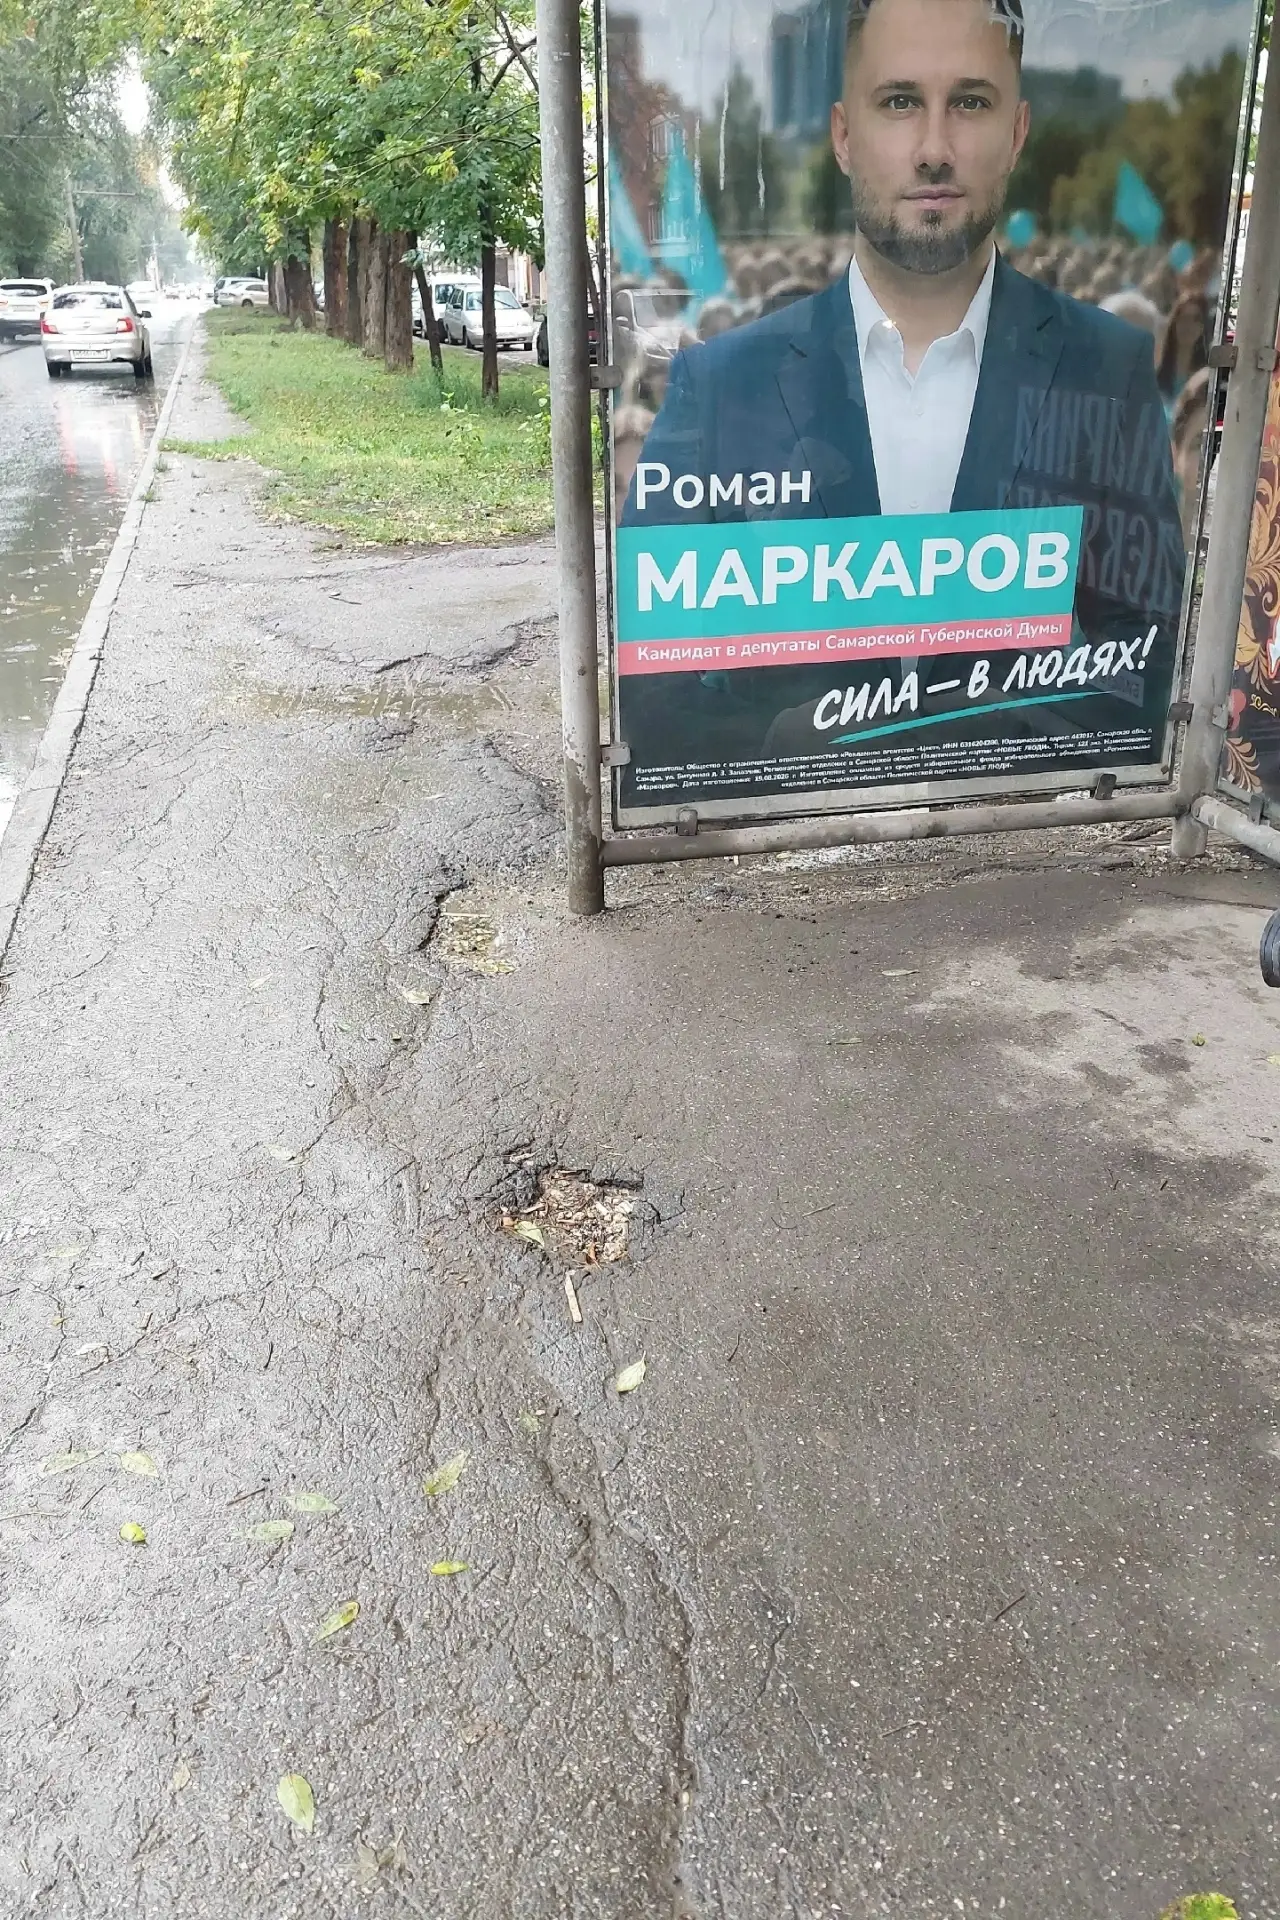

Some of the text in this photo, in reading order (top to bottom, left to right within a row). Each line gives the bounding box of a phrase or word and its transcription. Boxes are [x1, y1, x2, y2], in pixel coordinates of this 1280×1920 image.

[635, 462, 812, 511] Роман
[637, 531, 1070, 612] МАРКАРОВ
[637, 622, 1063, 661] Кандидат в депутаты Самарской Губернской Думы
[812, 672, 919, 730] СИЛА
[967, 660, 990, 698] В
[1002, 625, 1158, 693] ЛЮДЯХ!
